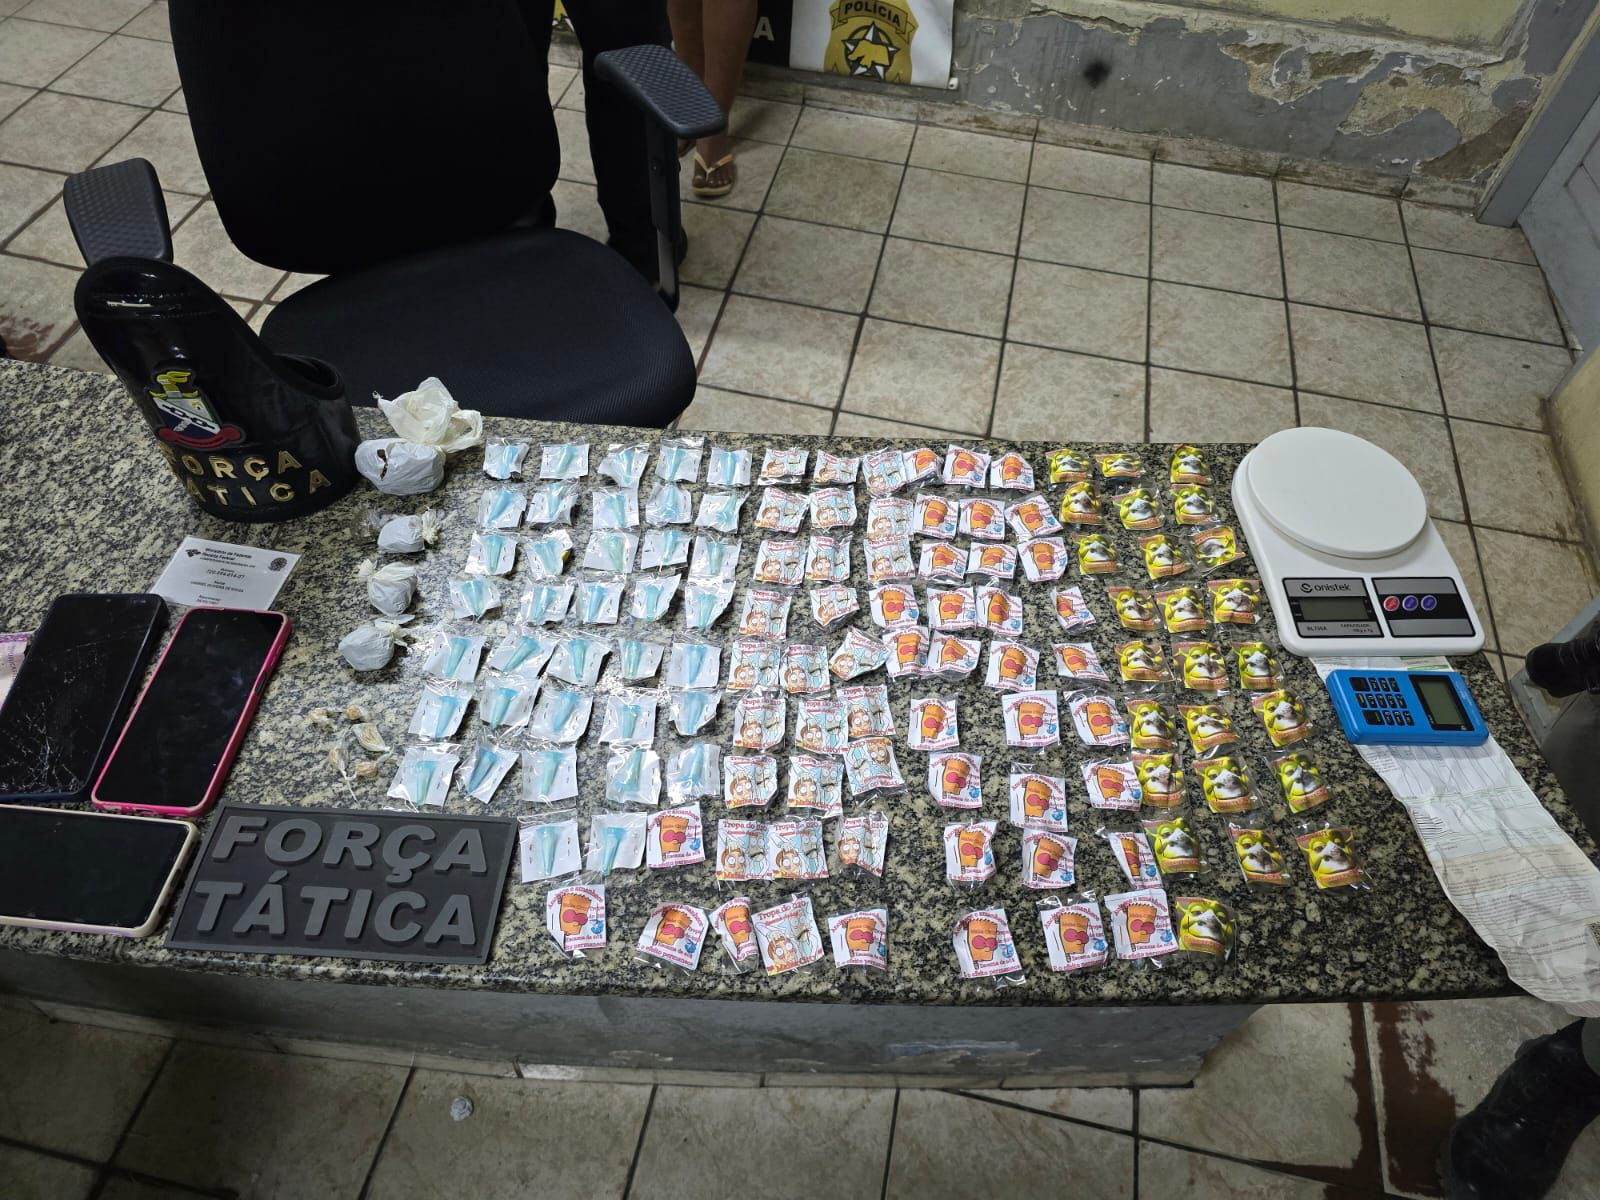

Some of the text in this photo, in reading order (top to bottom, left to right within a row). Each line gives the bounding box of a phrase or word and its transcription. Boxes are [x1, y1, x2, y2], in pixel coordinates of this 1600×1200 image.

[844, 2, 902, 27] POLÍCIA
[211, 815, 489, 887] FORÇA
[195, 870, 477, 950] TÁTICA
